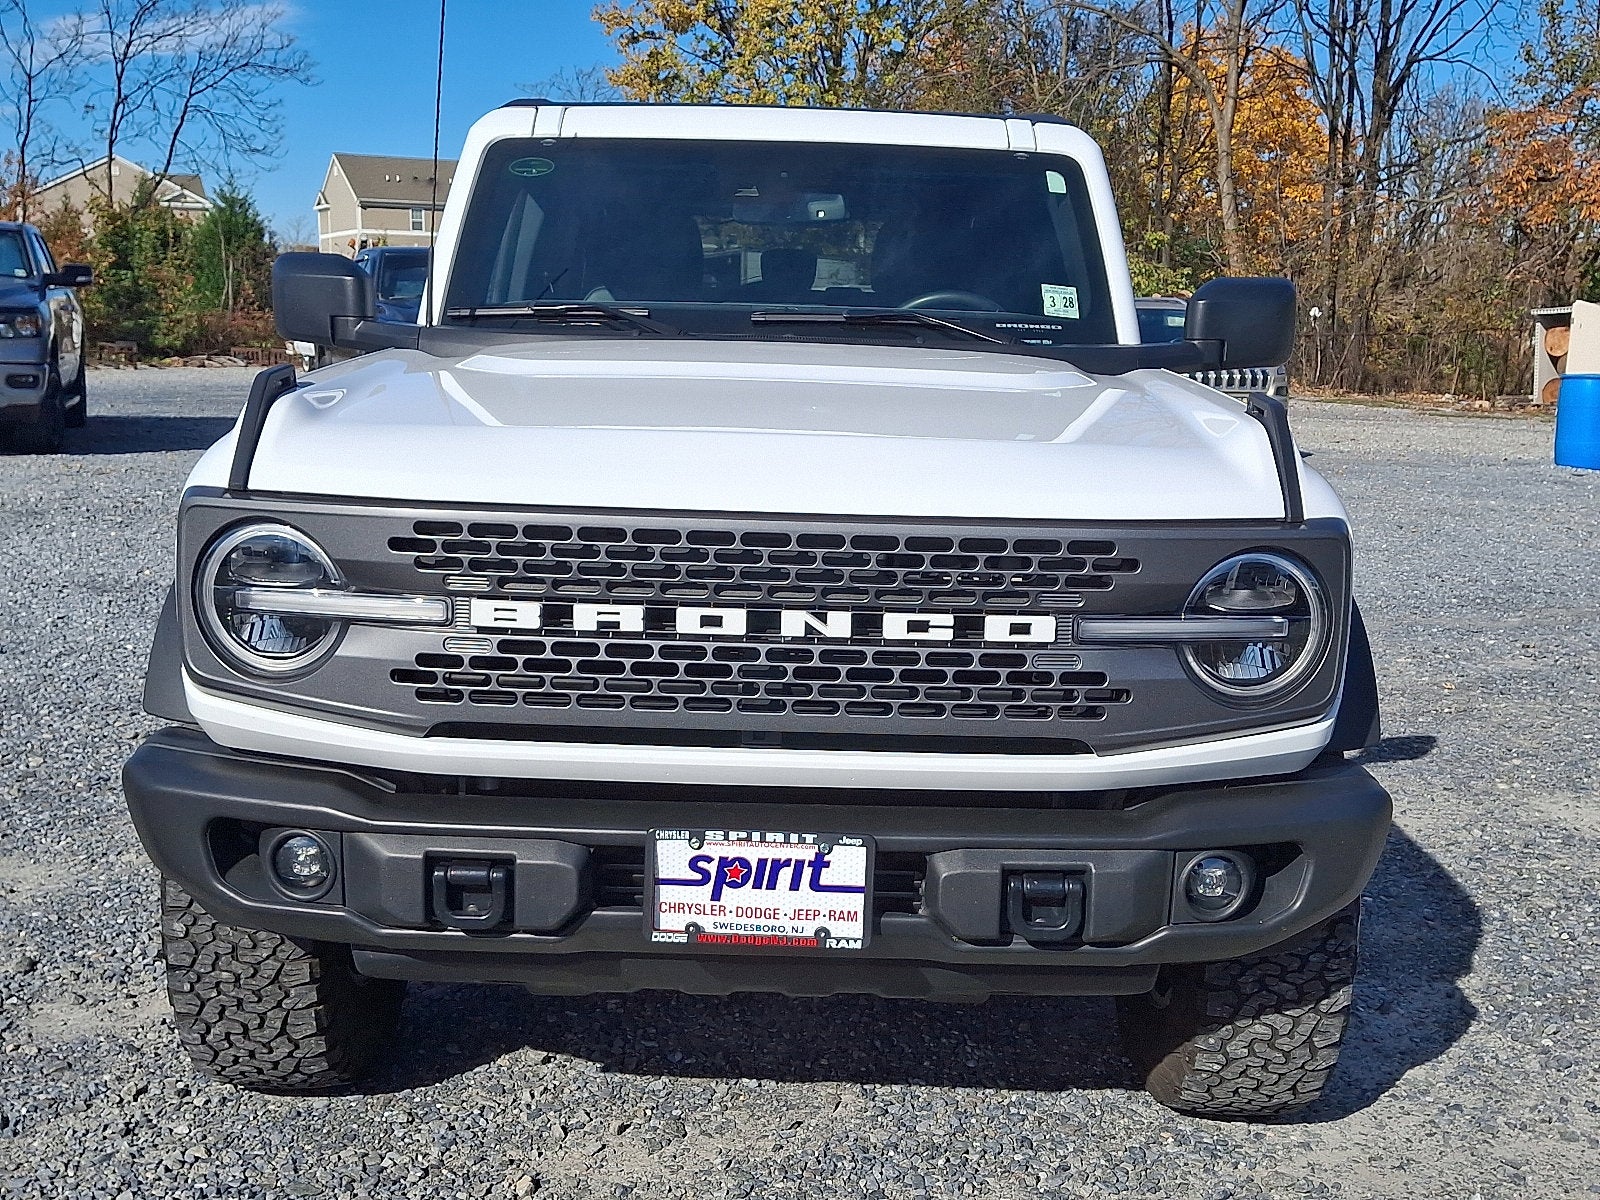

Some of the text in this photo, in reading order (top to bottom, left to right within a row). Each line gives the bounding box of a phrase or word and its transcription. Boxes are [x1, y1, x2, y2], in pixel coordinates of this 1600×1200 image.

[1049, 296, 1075, 309] 3 28
[470, 598, 1057, 643] BRONCO
[655, 829, 690, 840] CHRYSLER
[704, 830, 818, 844] SPIRIT
[838, 835, 863, 847] Jeep
[705, 841, 816, 850] www.SPIRITAUTOCENTER.com
[688, 852, 831, 902] spirit
[659, 901, 858, 922] CHRYSLER DODGE JEEP RAM
[712, 921, 805, 935] SWEDESBORO, NJ
[651, 932, 689, 943] DODGE
[697, 933, 818, 947] www.DodgeNJ.com
[825, 938, 863, 950] RAM
